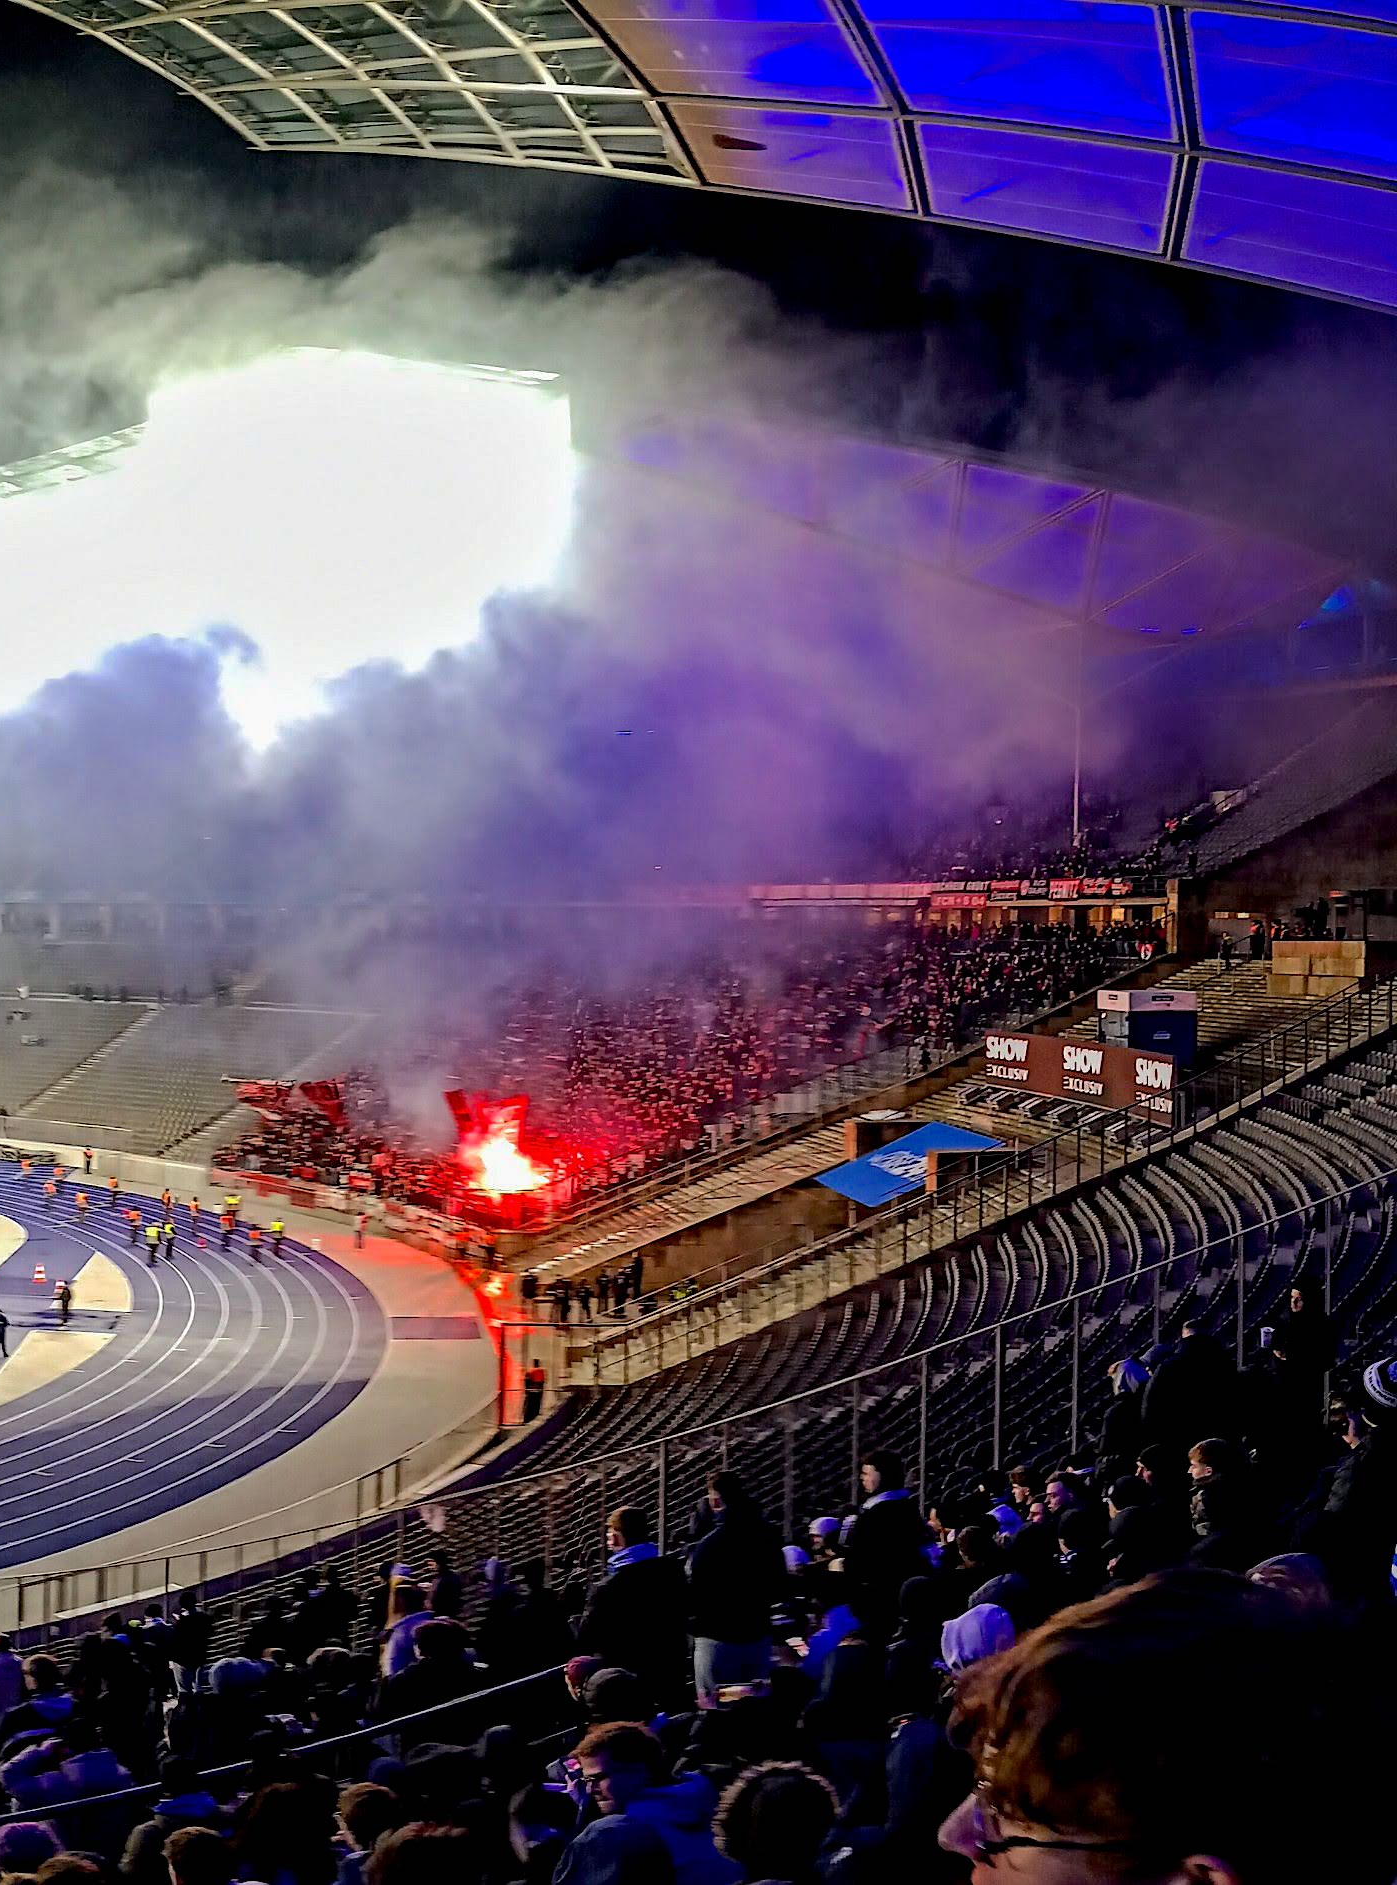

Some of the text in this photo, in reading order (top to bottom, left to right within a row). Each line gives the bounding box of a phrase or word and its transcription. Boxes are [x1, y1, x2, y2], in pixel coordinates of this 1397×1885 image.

[986, 1036, 1029, 1062] SHOW
[1063, 1046, 1103, 1074] SHOW
[1135, 1058, 1173, 1090] SHOW
